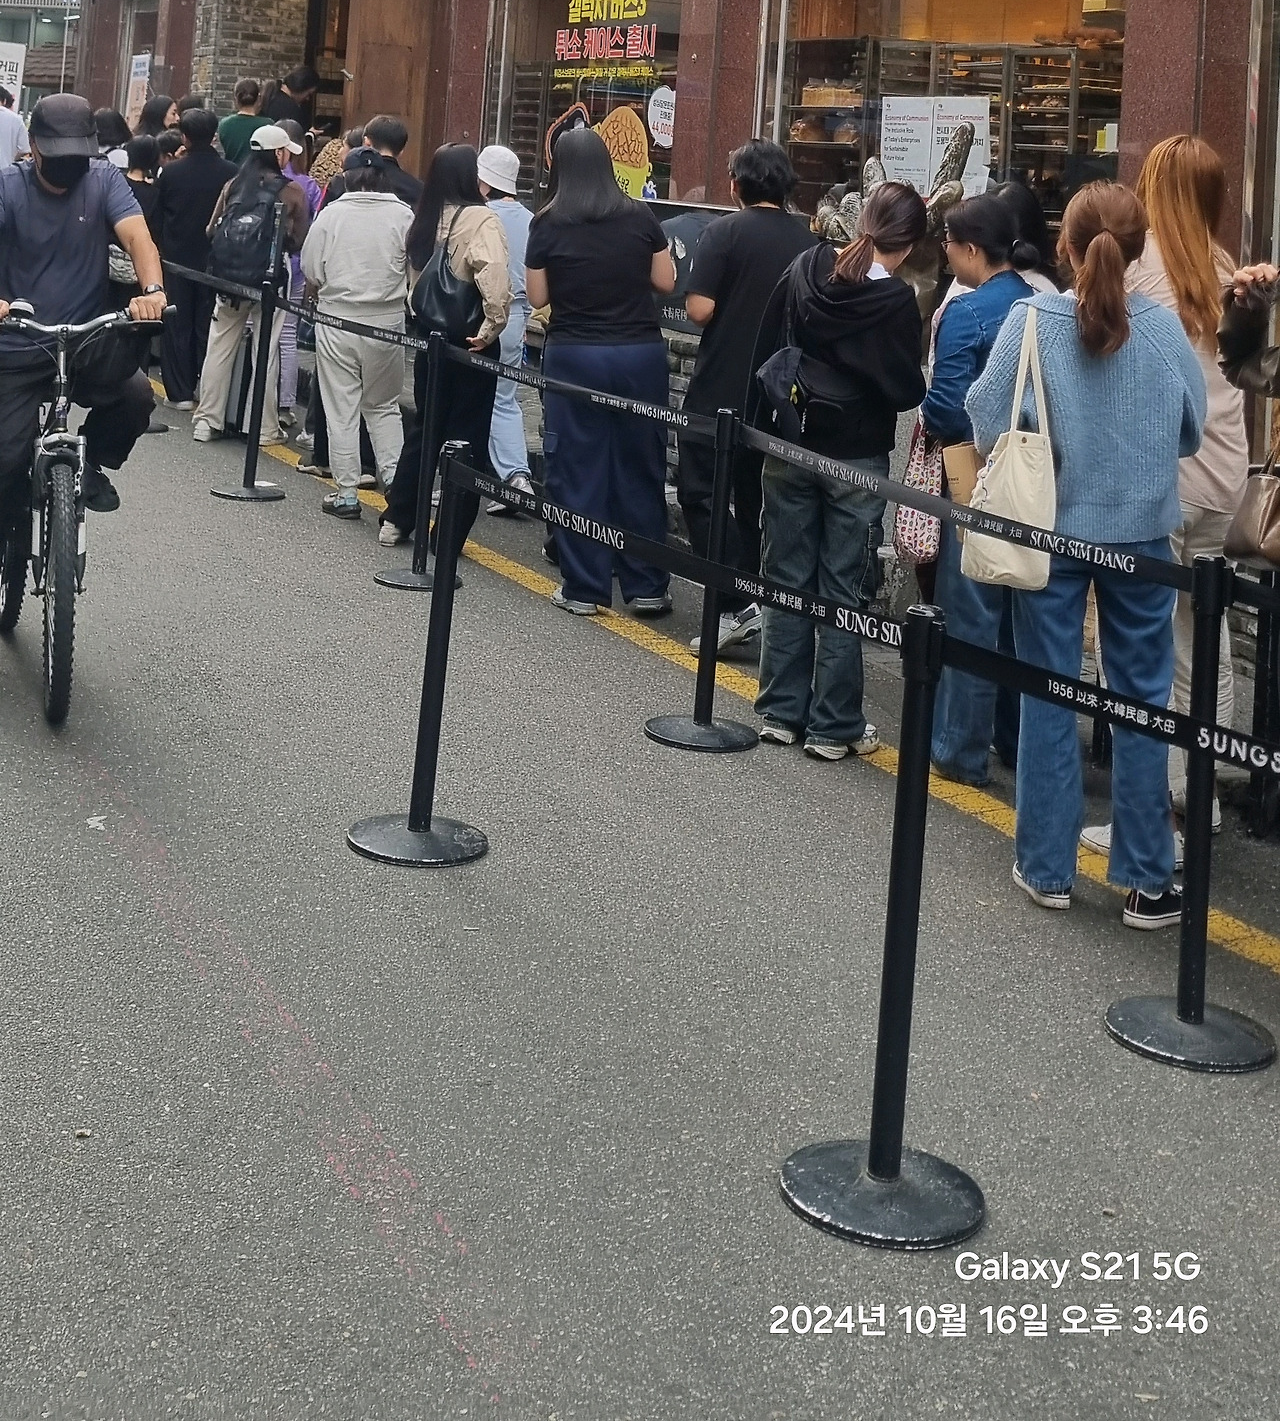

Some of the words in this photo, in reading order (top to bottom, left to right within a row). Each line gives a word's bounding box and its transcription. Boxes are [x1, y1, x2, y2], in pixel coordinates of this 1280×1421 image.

[554, 27, 581, 60] 튀소
[583, 26, 624, 59] 케이스
[625, 23, 658, 58] 출시
[631, 403, 689, 427] SUNGSIMDANG
[542, 502, 569, 528] SUNG
[571, 511, 593, 535] SIM
[594, 521, 626, 550] DANG
[1029, 529, 1066, 554] SUNG
[1067, 538, 1092, 562] SIM
[1094, 547, 1136, 574] DANG
[835, 606, 879, 639] SUNG
